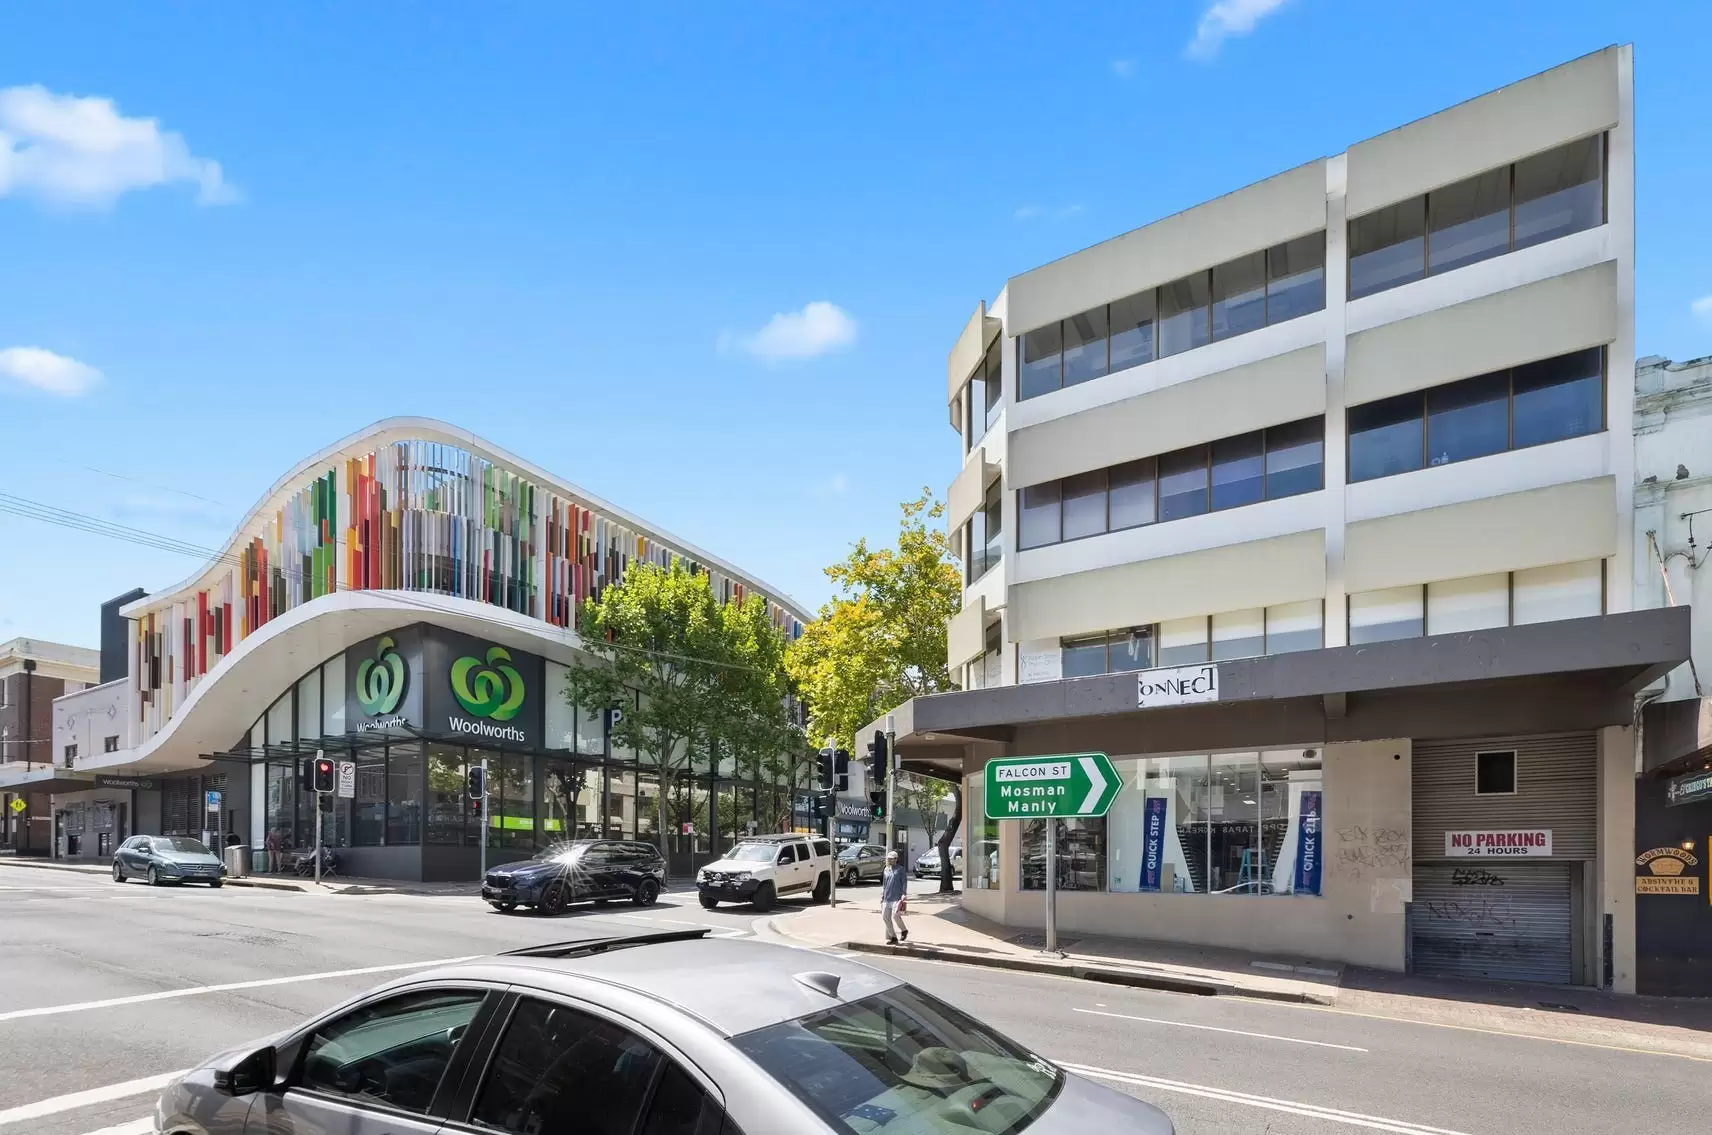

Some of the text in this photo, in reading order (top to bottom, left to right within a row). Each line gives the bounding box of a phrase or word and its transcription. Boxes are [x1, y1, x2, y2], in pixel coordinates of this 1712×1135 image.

[1139, 667, 1216, 705] ONNECT
[449, 716, 525, 742] Woolworths
[998, 766, 1068, 778] FALCON ST
[1001, 785, 1065, 797] Mosman
[841, 803, 871, 817] oolworth
[1008, 801, 1057, 814] Manly
[1150, 814, 1160, 836] STEP
[1451, 832, 1546, 847] NO PARKING
[1148, 838, 1158, 869] QUICK
[1467, 847, 1481, 855] 24
[1637, 848, 1697, 865] WORMWOODS
